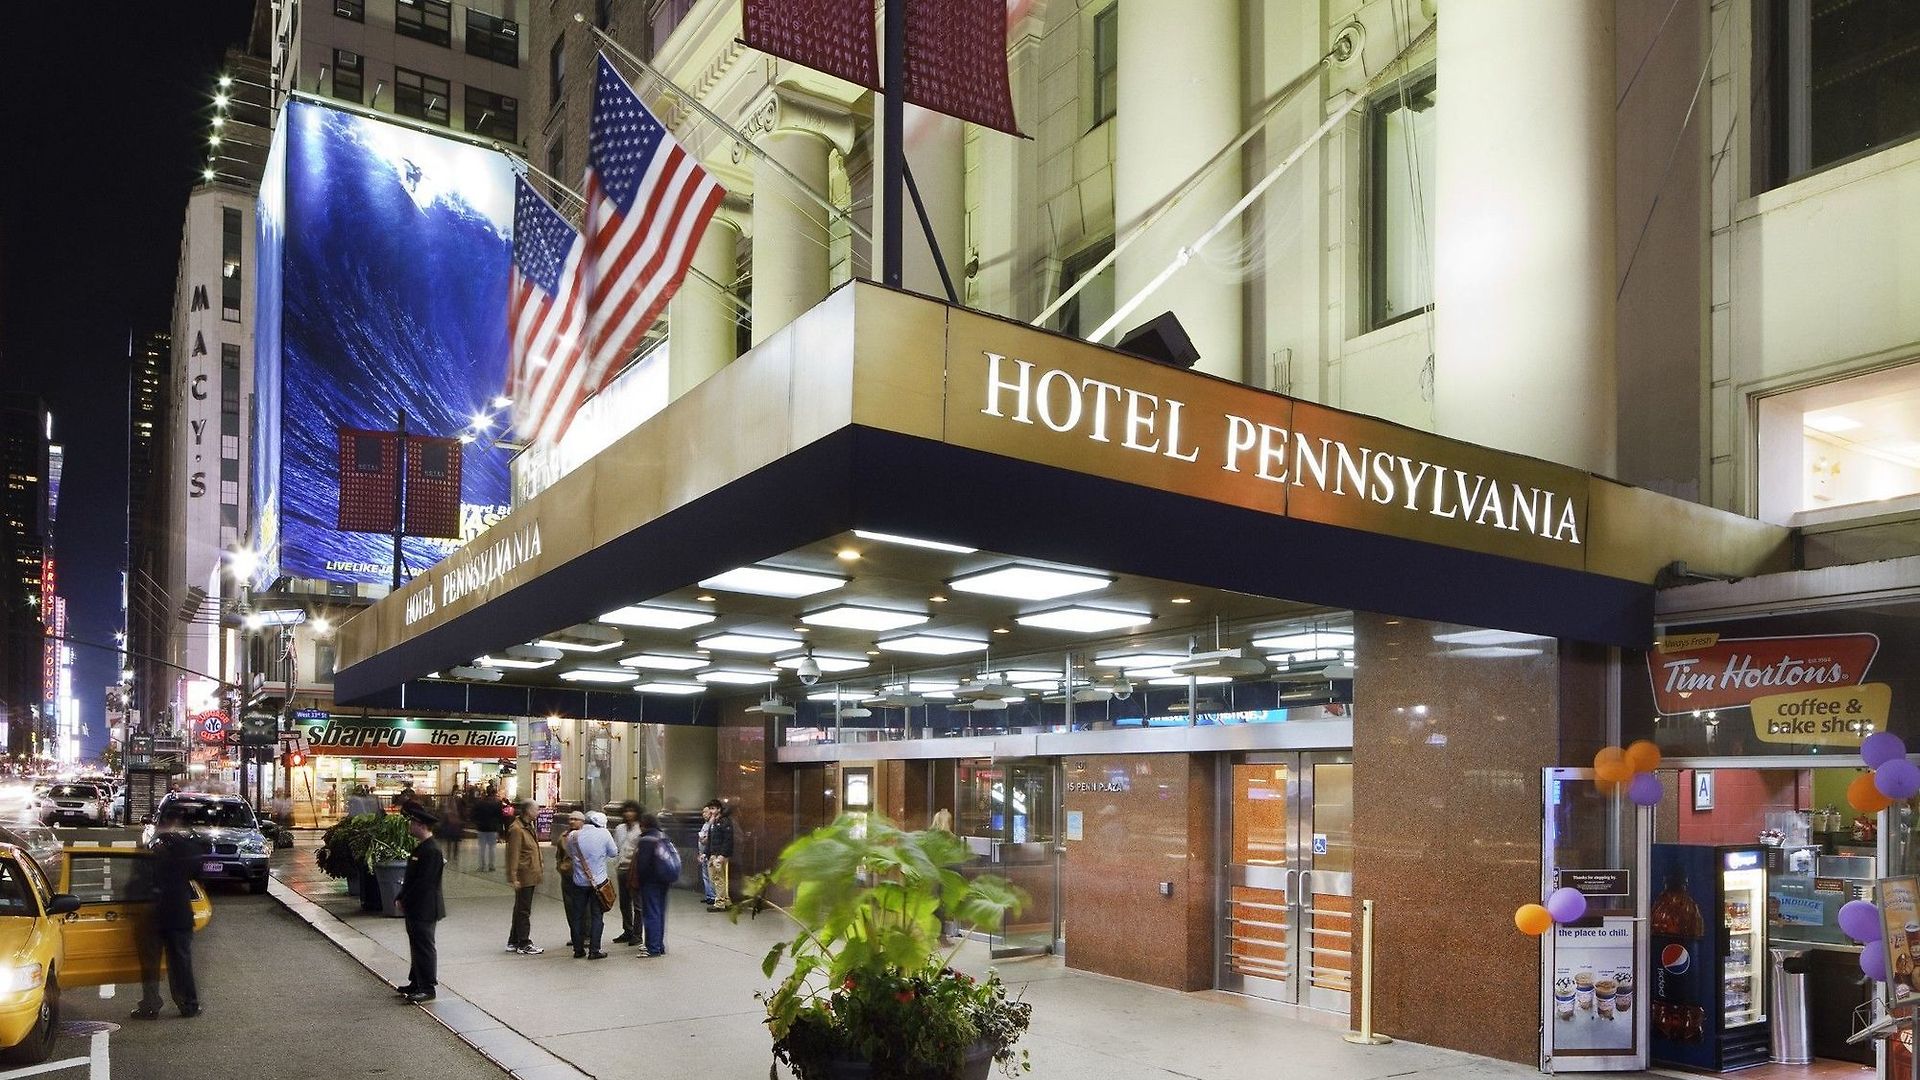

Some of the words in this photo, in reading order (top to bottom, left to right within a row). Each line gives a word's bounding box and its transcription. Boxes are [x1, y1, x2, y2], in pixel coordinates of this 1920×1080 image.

[190, 284, 210, 498] MACY'S
[980, 350, 1200, 463] HOTEL
[1221, 413, 1581, 544] PENNSYLVANIA
[46, 560, 54, 615] ERNST
[405, 584, 436, 626] HOTEL
[442, 521, 542, 607] PENNSYLVANIA
[46, 645, 54, 700] YOUNG
[1663, 658, 1717, 693] Tim
[1777, 698, 1842, 716] coffee
[1845, 698, 1863, 714] &
[307, 719, 406, 748] sbarro
[430, 729, 459, 745] the
[464, 731, 517, 746] Italian
[1767, 717, 1816, 735] bake
[1821, 716, 1873, 737] shop
[1100, 782, 1122, 792] PLAZA
[1698, 777, 1709, 797] A
[1558, 929, 1573, 937] the
[1574, 929, 1596, 938] place
[1598, 929, 1607, 937] to
[1609, 929, 1629, 937] chill.
